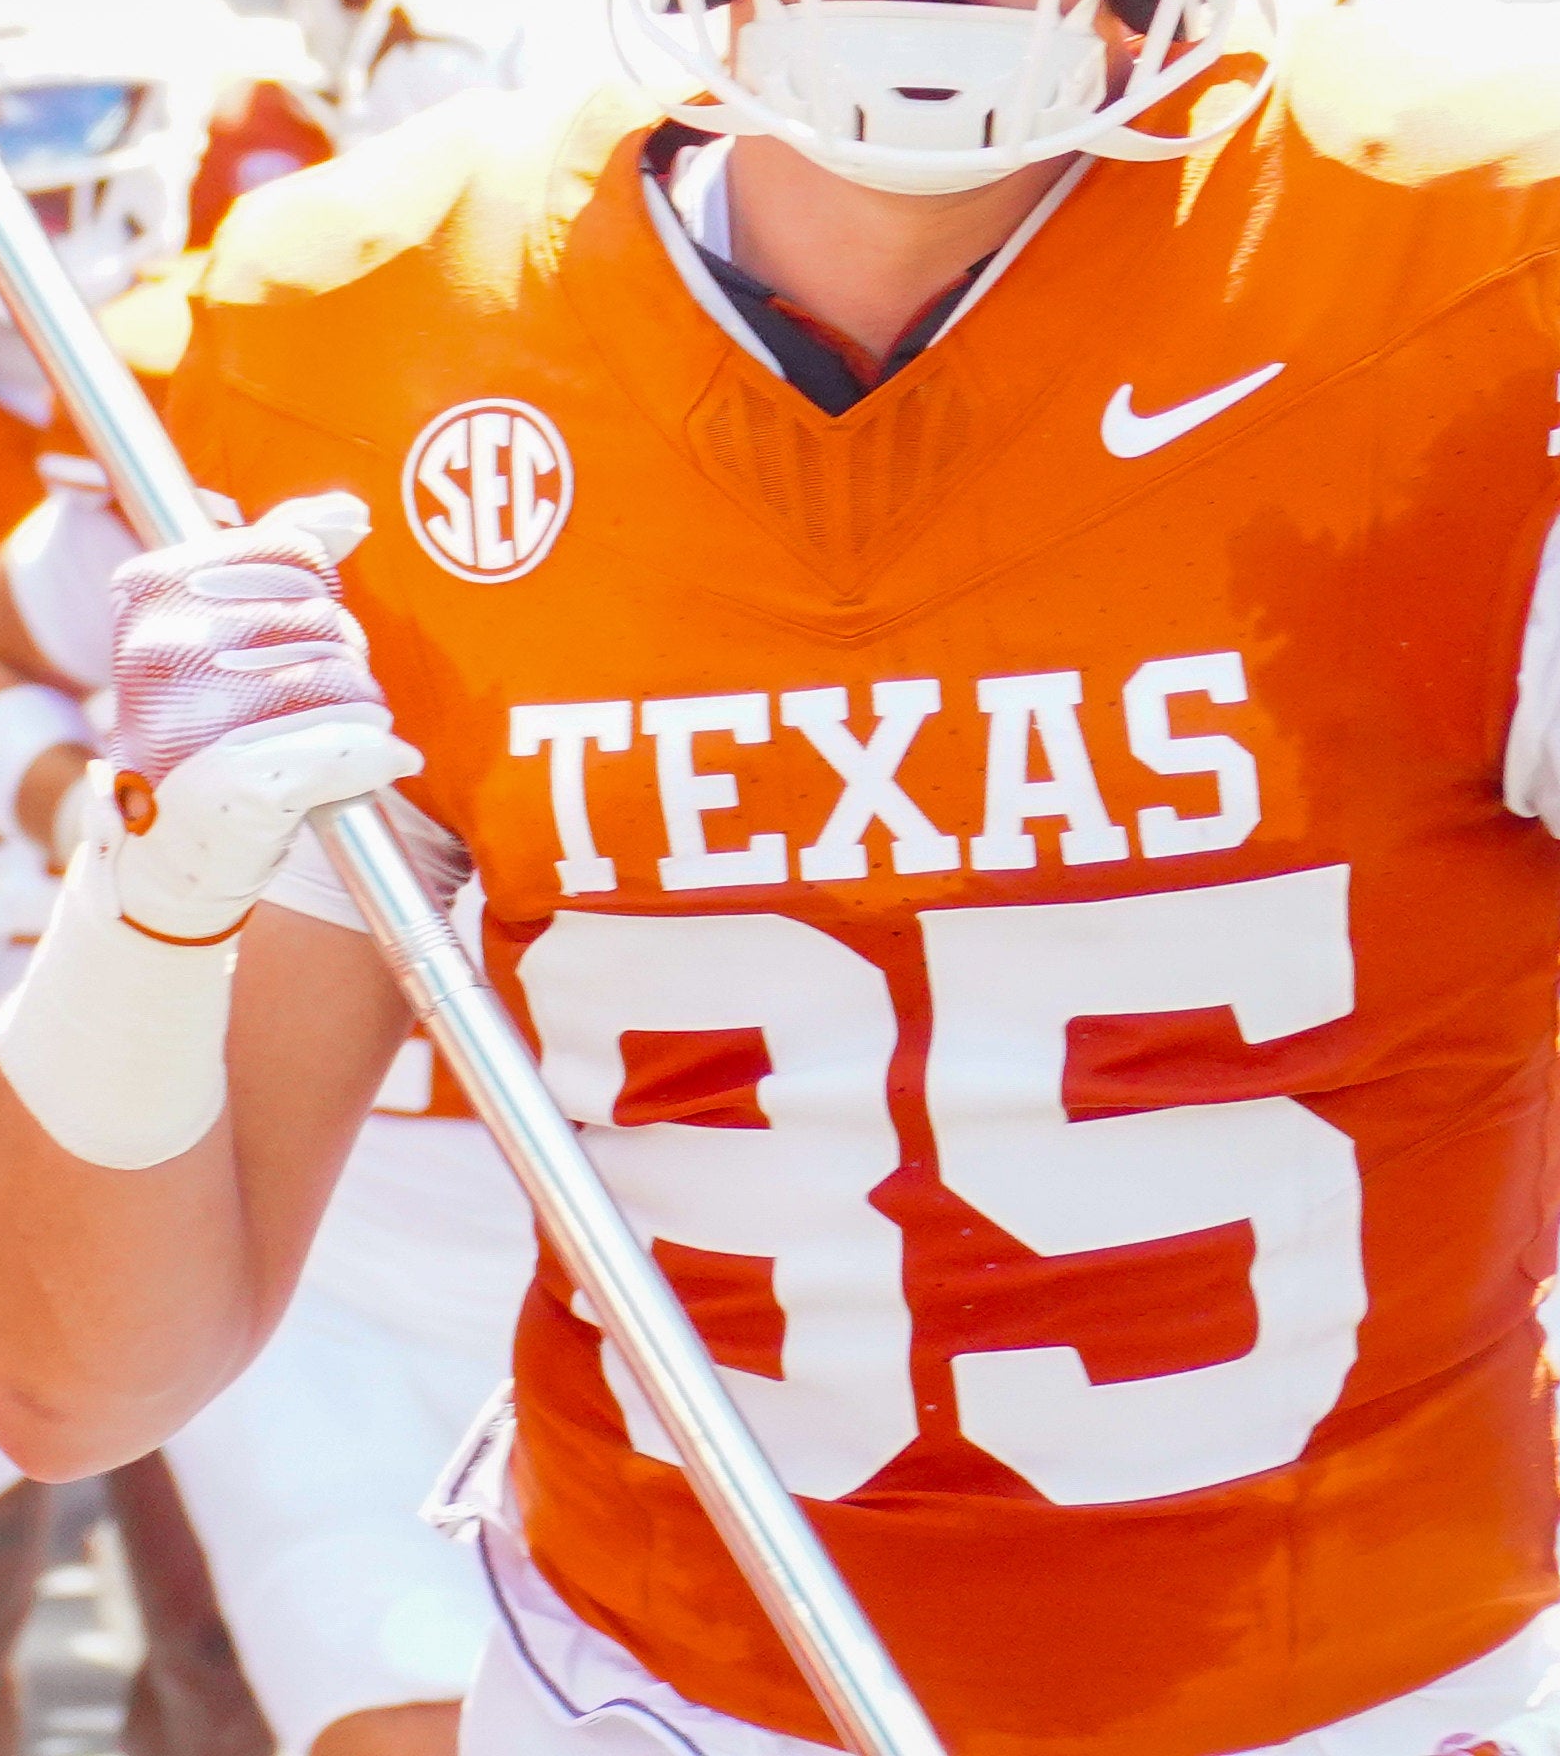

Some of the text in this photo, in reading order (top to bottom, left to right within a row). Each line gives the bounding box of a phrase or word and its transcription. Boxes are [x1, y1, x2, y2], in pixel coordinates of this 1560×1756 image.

[416, 410, 558, 572] SEC
[508, 651, 1263, 897] TEXAS
[516, 863, 1370, 1507] 85
